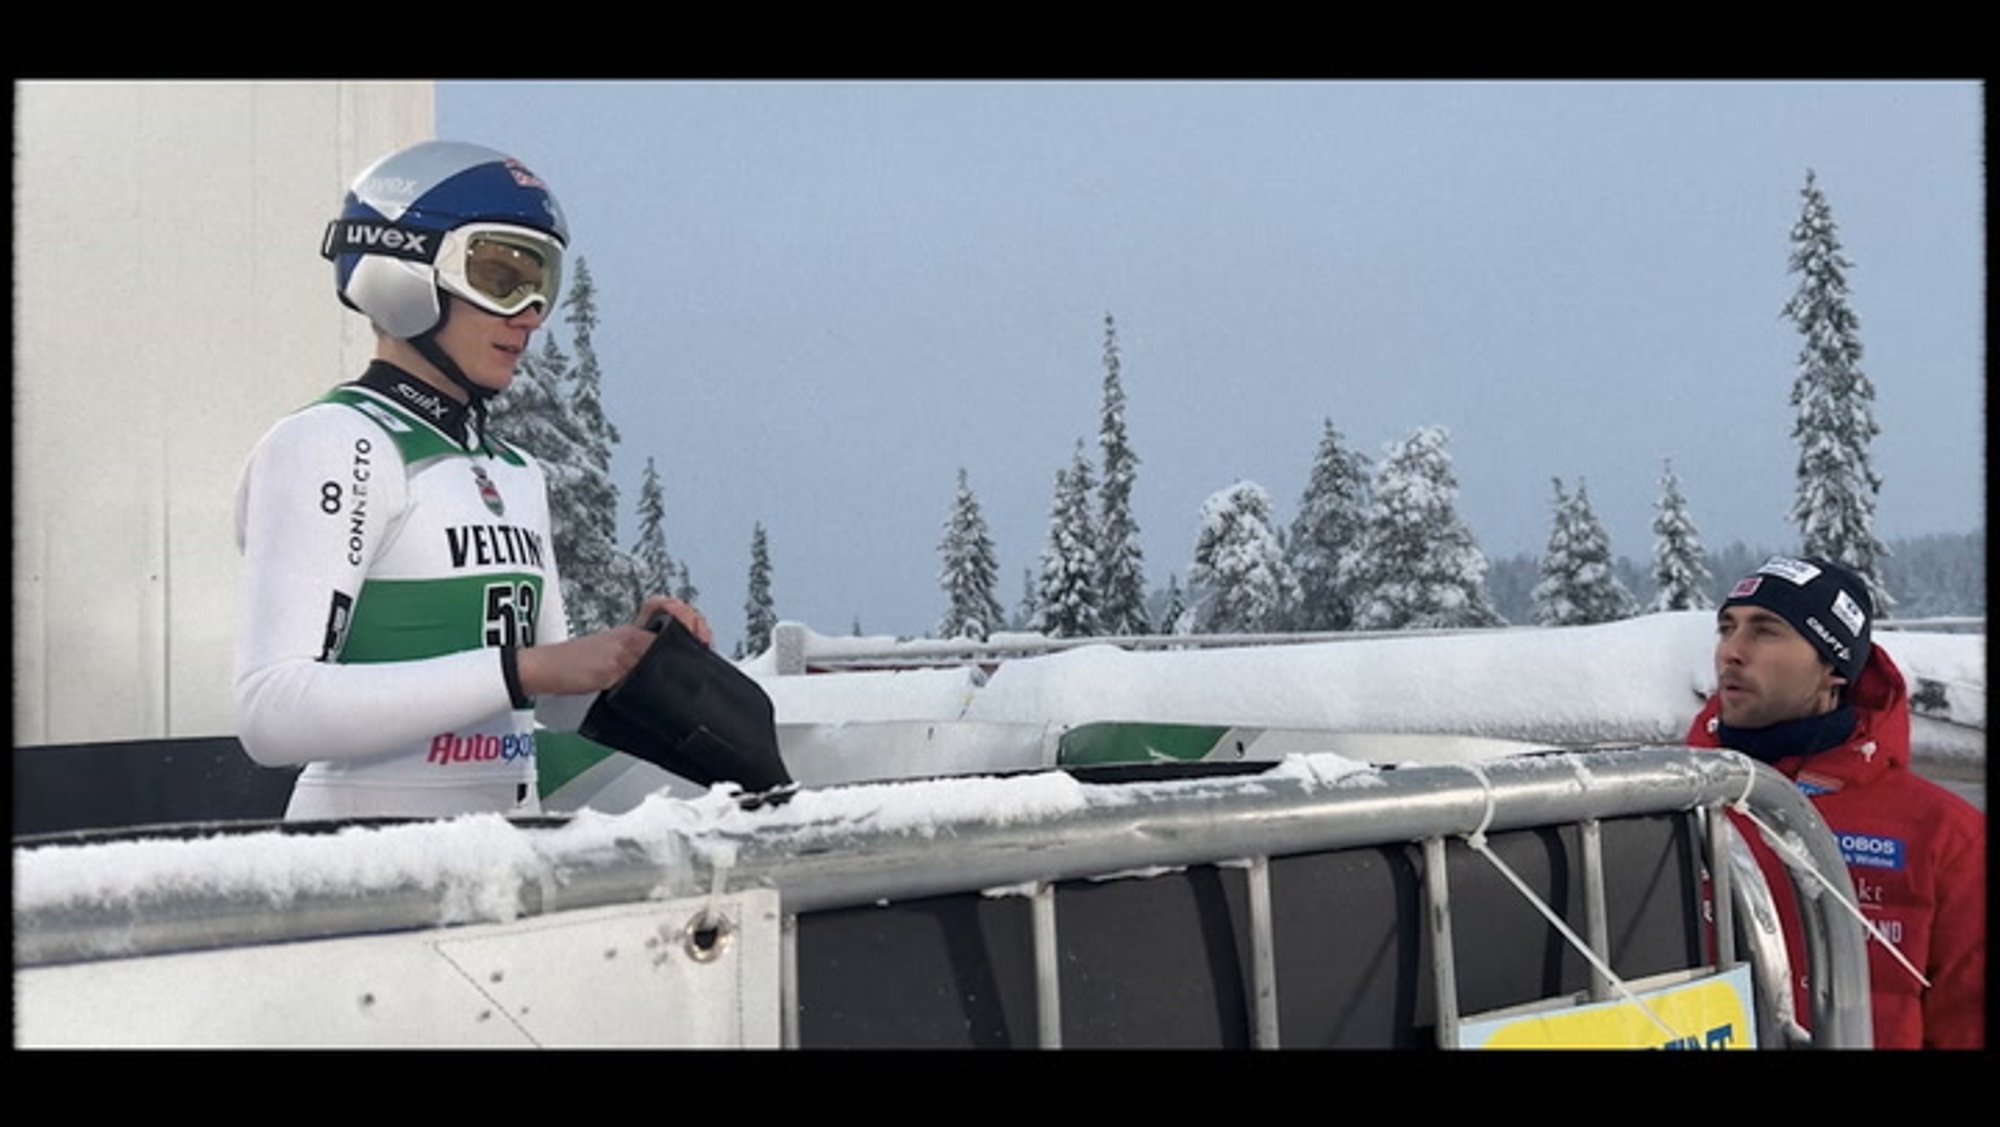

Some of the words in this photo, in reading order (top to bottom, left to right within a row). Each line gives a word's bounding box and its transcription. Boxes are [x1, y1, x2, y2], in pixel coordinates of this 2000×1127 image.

[347, 225, 426, 252] uvex
[445, 525, 543, 569] VELTIN
[484, 583, 536, 648] 53
[1842, 836, 1896, 854] OBOS
